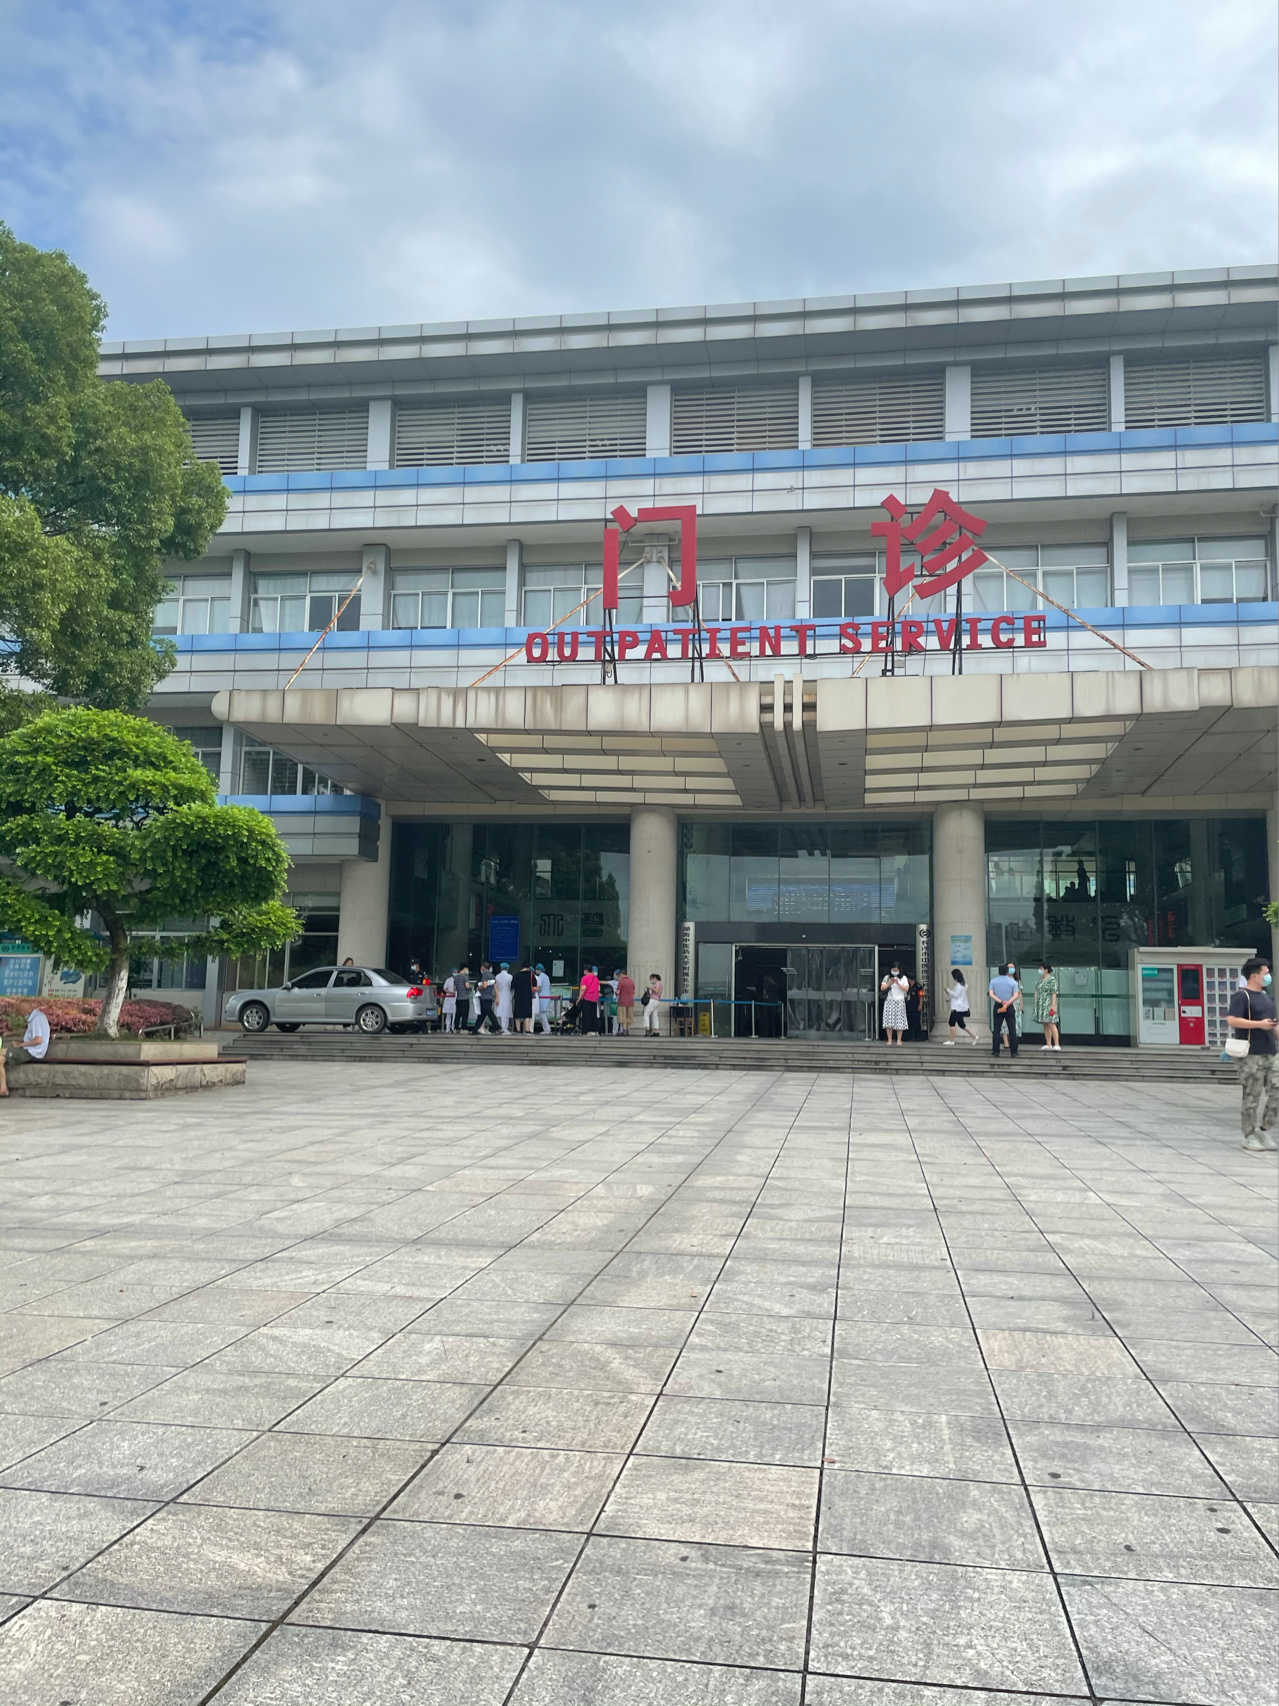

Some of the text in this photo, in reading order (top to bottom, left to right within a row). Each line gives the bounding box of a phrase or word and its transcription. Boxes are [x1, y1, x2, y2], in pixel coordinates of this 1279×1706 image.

[603, 488, 989, 609] 门诊
[525, 615, 1047, 663] OUTPATIENT SERVICE
